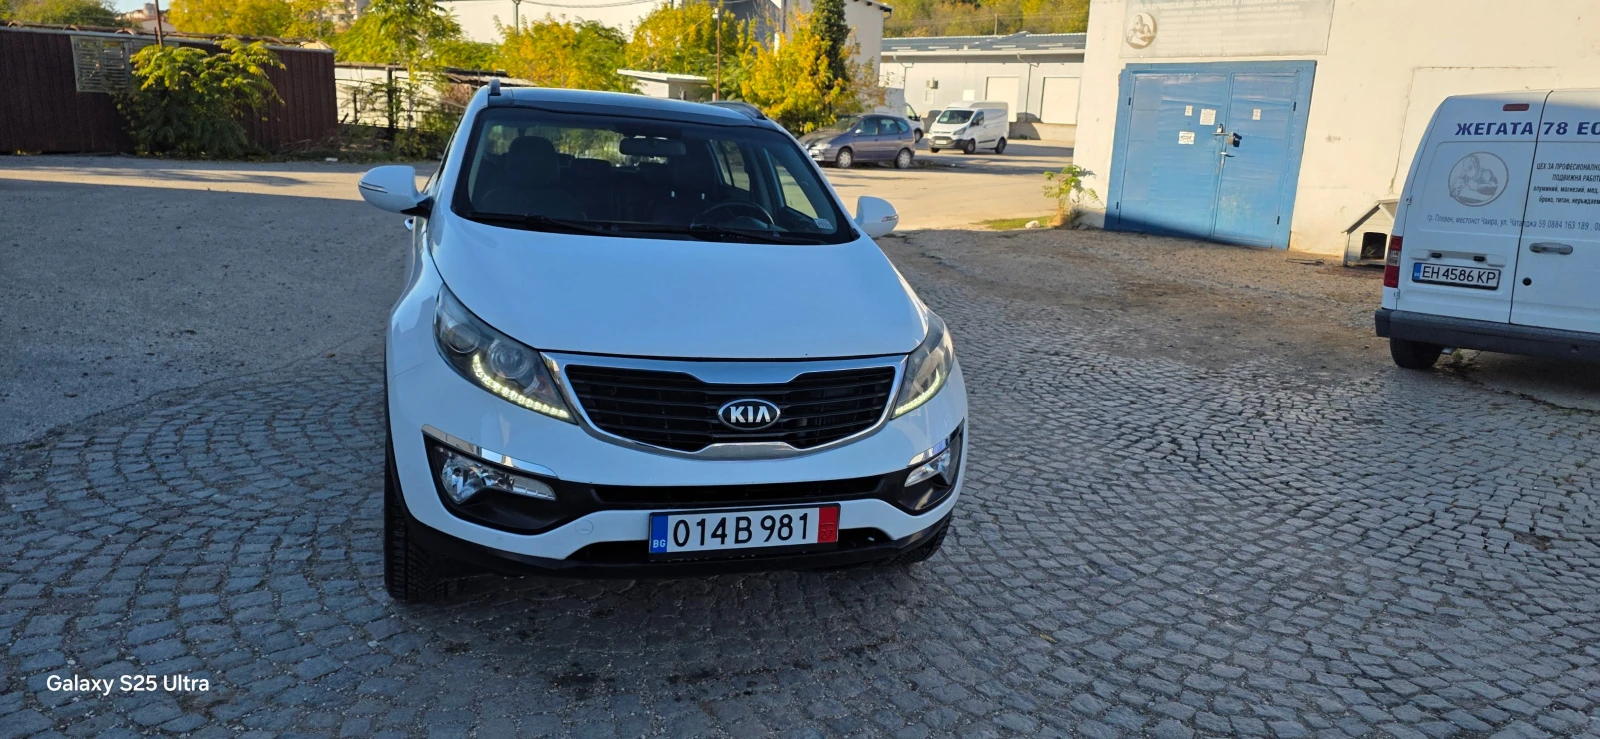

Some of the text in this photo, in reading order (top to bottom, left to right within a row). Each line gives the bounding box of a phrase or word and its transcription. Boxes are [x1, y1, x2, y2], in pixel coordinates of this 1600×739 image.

[1455, 122, 1534, 136] ЖЕГАТА
[1543, 121, 1568, 136] 78
[1552, 174, 1582, 182] ПОДВИЖНА
[1538, 220, 1547, 229] 59
[1547, 220, 1563, 229] 0884
[1565, 220, 1576, 230] 163
[1577, 221, 1590, 231] 189
[1422, 265, 1441, 279] EH
[1442, 267, 1474, 282] 4586
[1476, 270, 1496, 284] KP
[729, 405, 771, 423] KIA
[653, 539, 666, 548] BG
